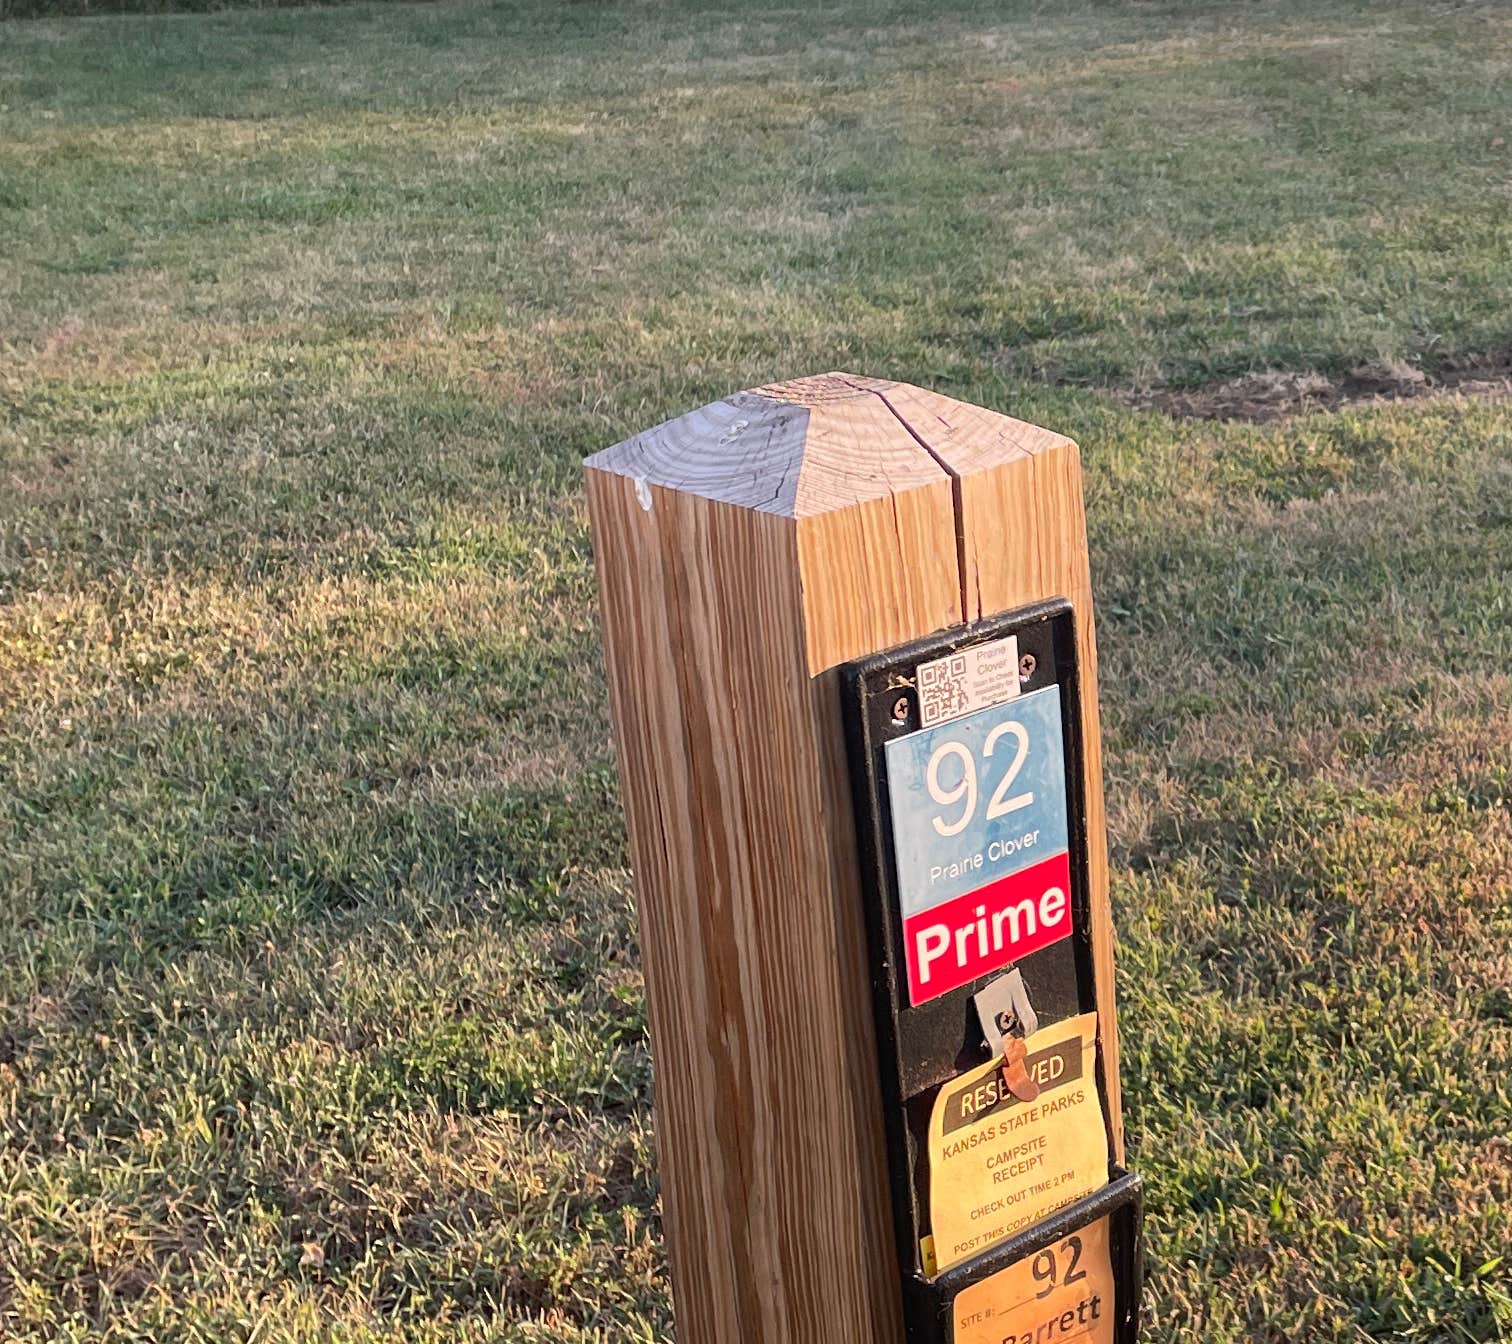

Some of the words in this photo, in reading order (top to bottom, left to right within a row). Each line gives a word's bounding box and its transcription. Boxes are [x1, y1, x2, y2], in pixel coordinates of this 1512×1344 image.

[925, 720, 1035, 837] 92
[930, 852, 984, 885] Prairie
[988, 828, 1040, 862] Clover
[915, 885, 1066, 985] Prime
[942, 1126, 996, 1160] KANSAS
[999, 1108, 1039, 1135] STATE
[1042, 1090, 1085, 1118] PARKS
[986, 1135, 1048, 1169] CAMPSITE
[970, 1199, 1004, 1221] CHECK
[1006, 1189, 1026, 1206] OUT
[1028, 1180, 1052, 1197] TIME
[1054, 1177, 1060, 1187] 2
[1061, 1170, 1076, 1184] PM
[993, 1154, 1045, 1184] RECEIPT
[954, 1237, 981, 1255] POST
[982, 1226, 1005, 1243] THIS
[1006, 1215, 1033, 1233] COPY
[1034, 1207, 1047, 1221] AT
[960, 1311, 983, 1330] SITE
[1032, 1236, 1087, 1299] 92
